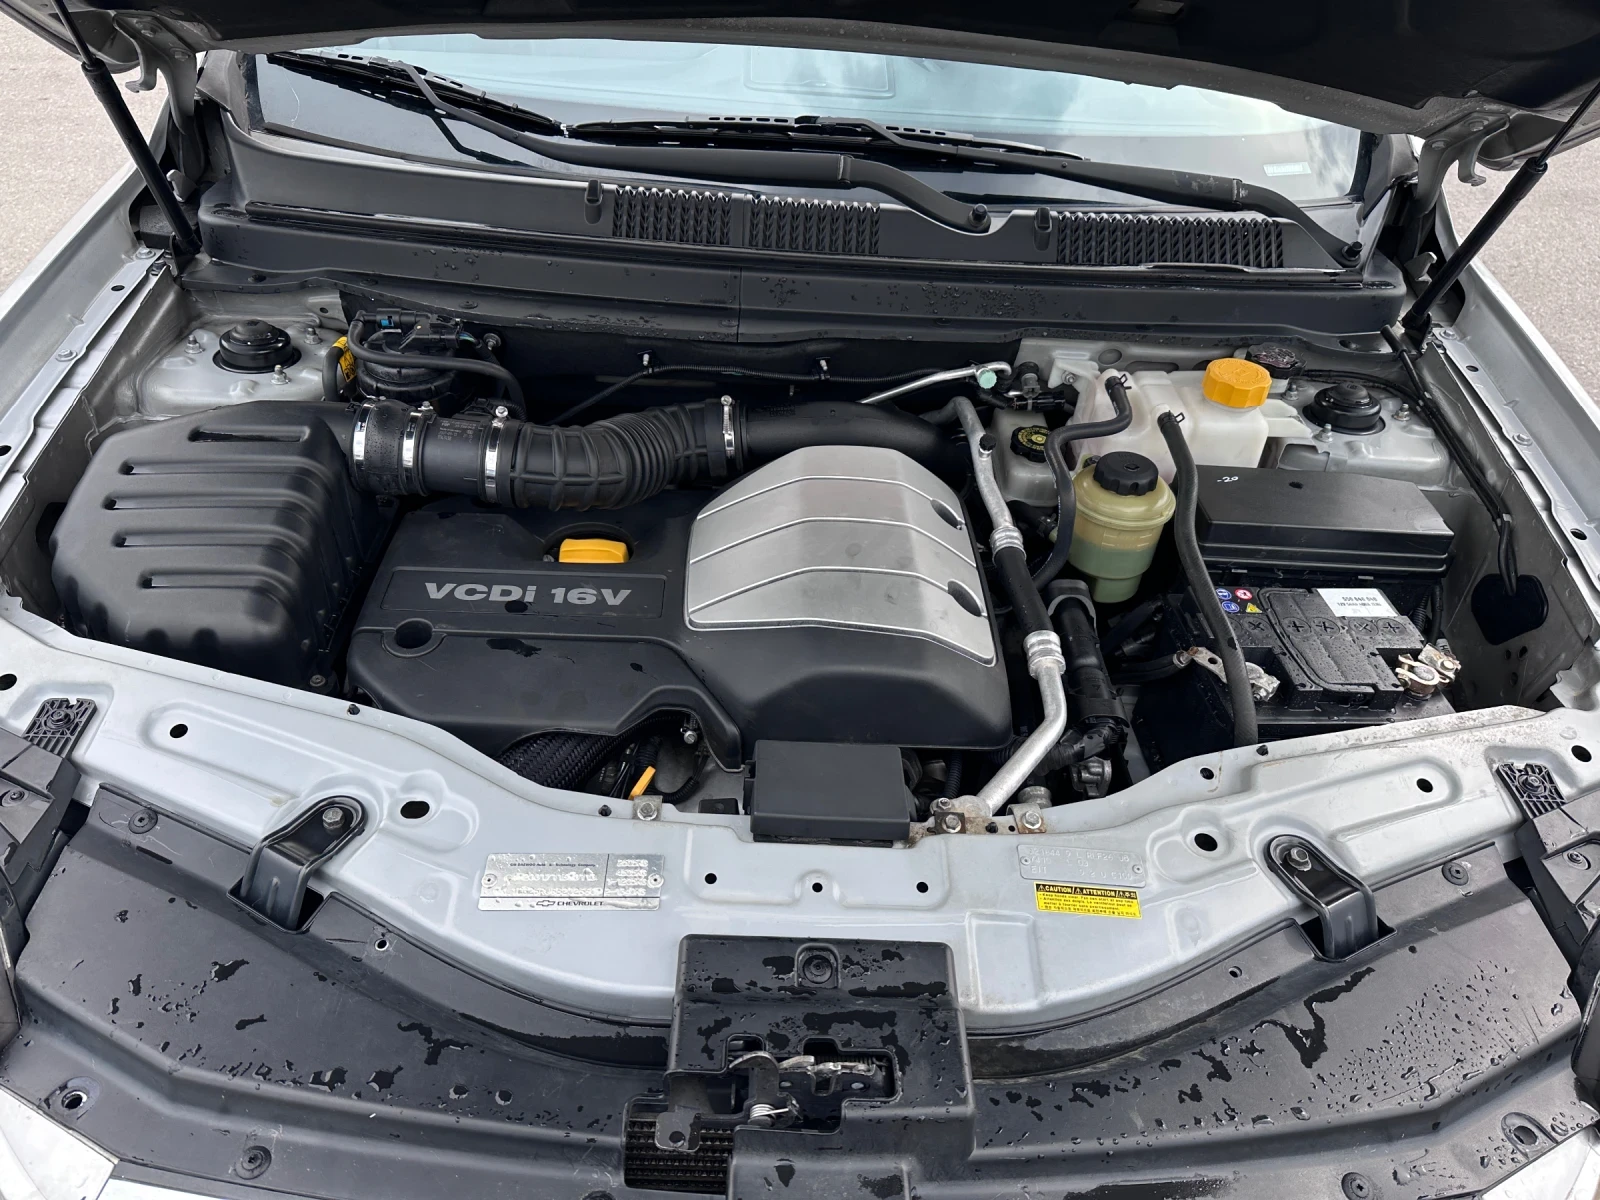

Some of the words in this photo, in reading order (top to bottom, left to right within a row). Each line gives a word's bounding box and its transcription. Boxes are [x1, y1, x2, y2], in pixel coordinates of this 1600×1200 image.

[424, 582, 537, 603] VCDi
[551, 587, 632, 606] 16V
[1082, 888, 1116, 896] ATTENTION
